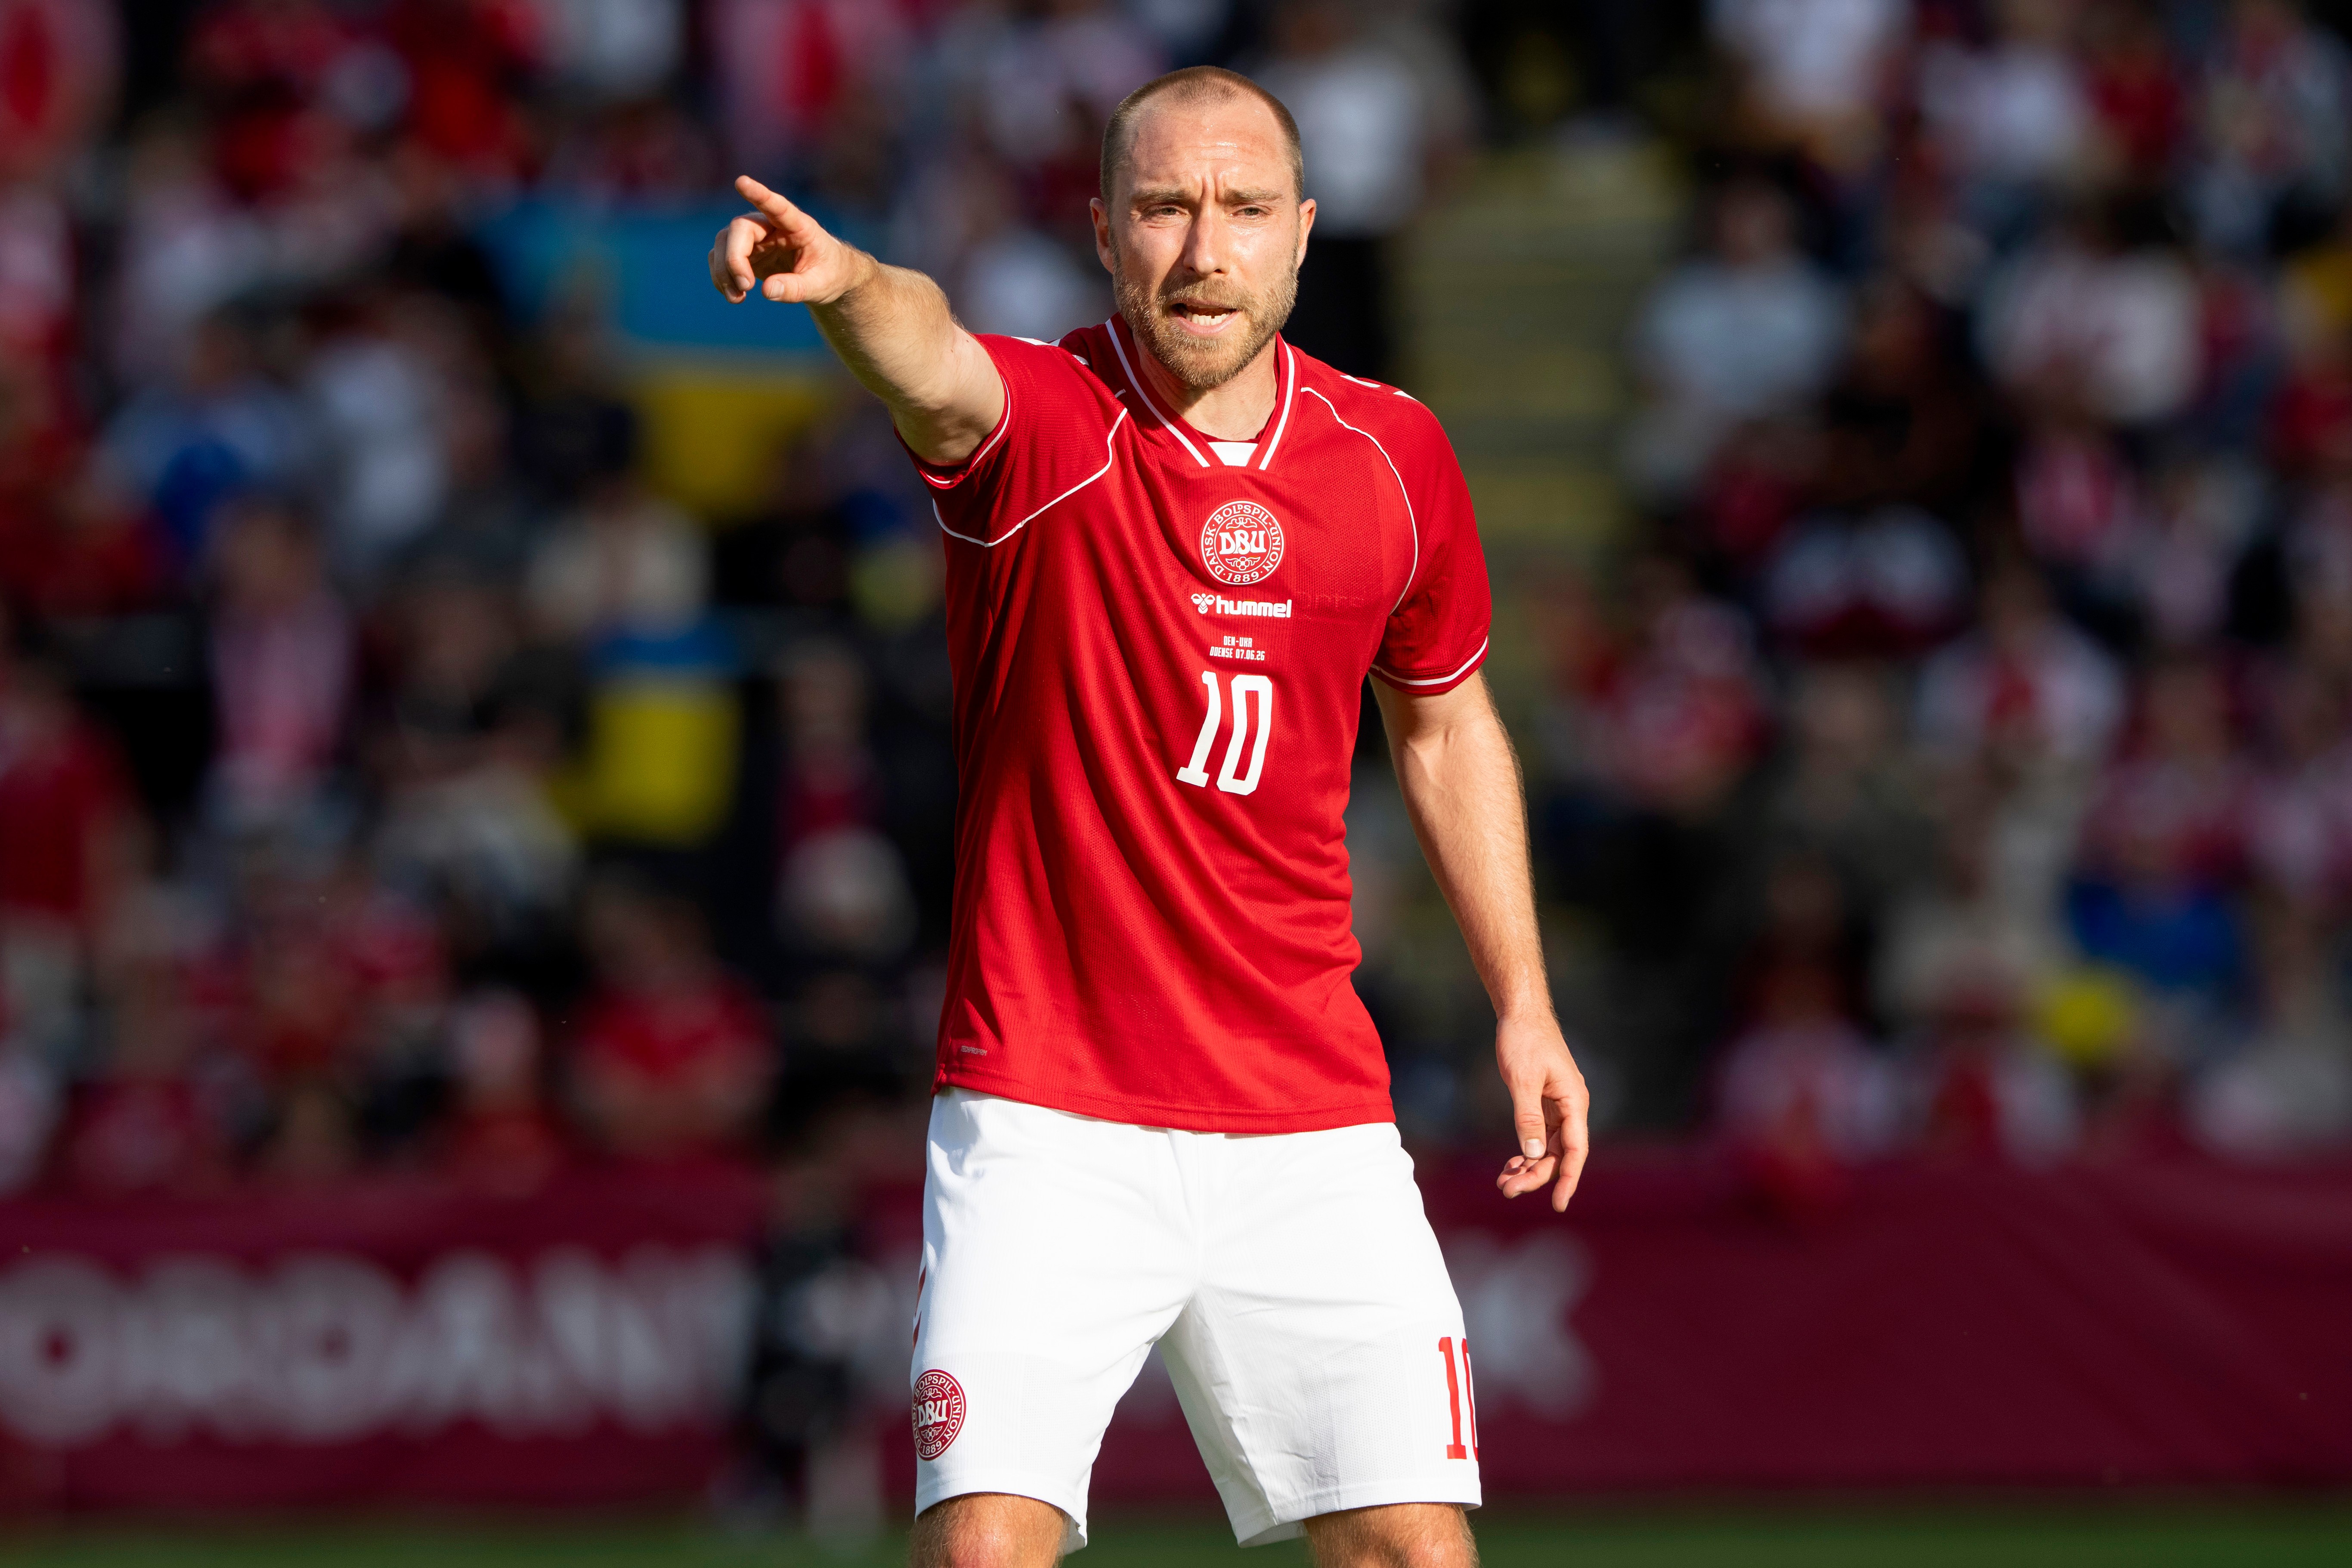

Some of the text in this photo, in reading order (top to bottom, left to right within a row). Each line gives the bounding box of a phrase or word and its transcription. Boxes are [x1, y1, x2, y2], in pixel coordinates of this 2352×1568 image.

[1205, 528, 1224, 576] DANSK
[1219, 529, 1266, 555] DBU
[1226, 571, 1260, 583] 1889
[1216, 595, 1292, 618] hummel
[1209, 646, 1265, 661] ODENSE 07.06.26
[1176, 670, 1272, 795] 10
[917, 1399, 948, 1428] DBU
[922, 1442, 942, 1455] 1889
